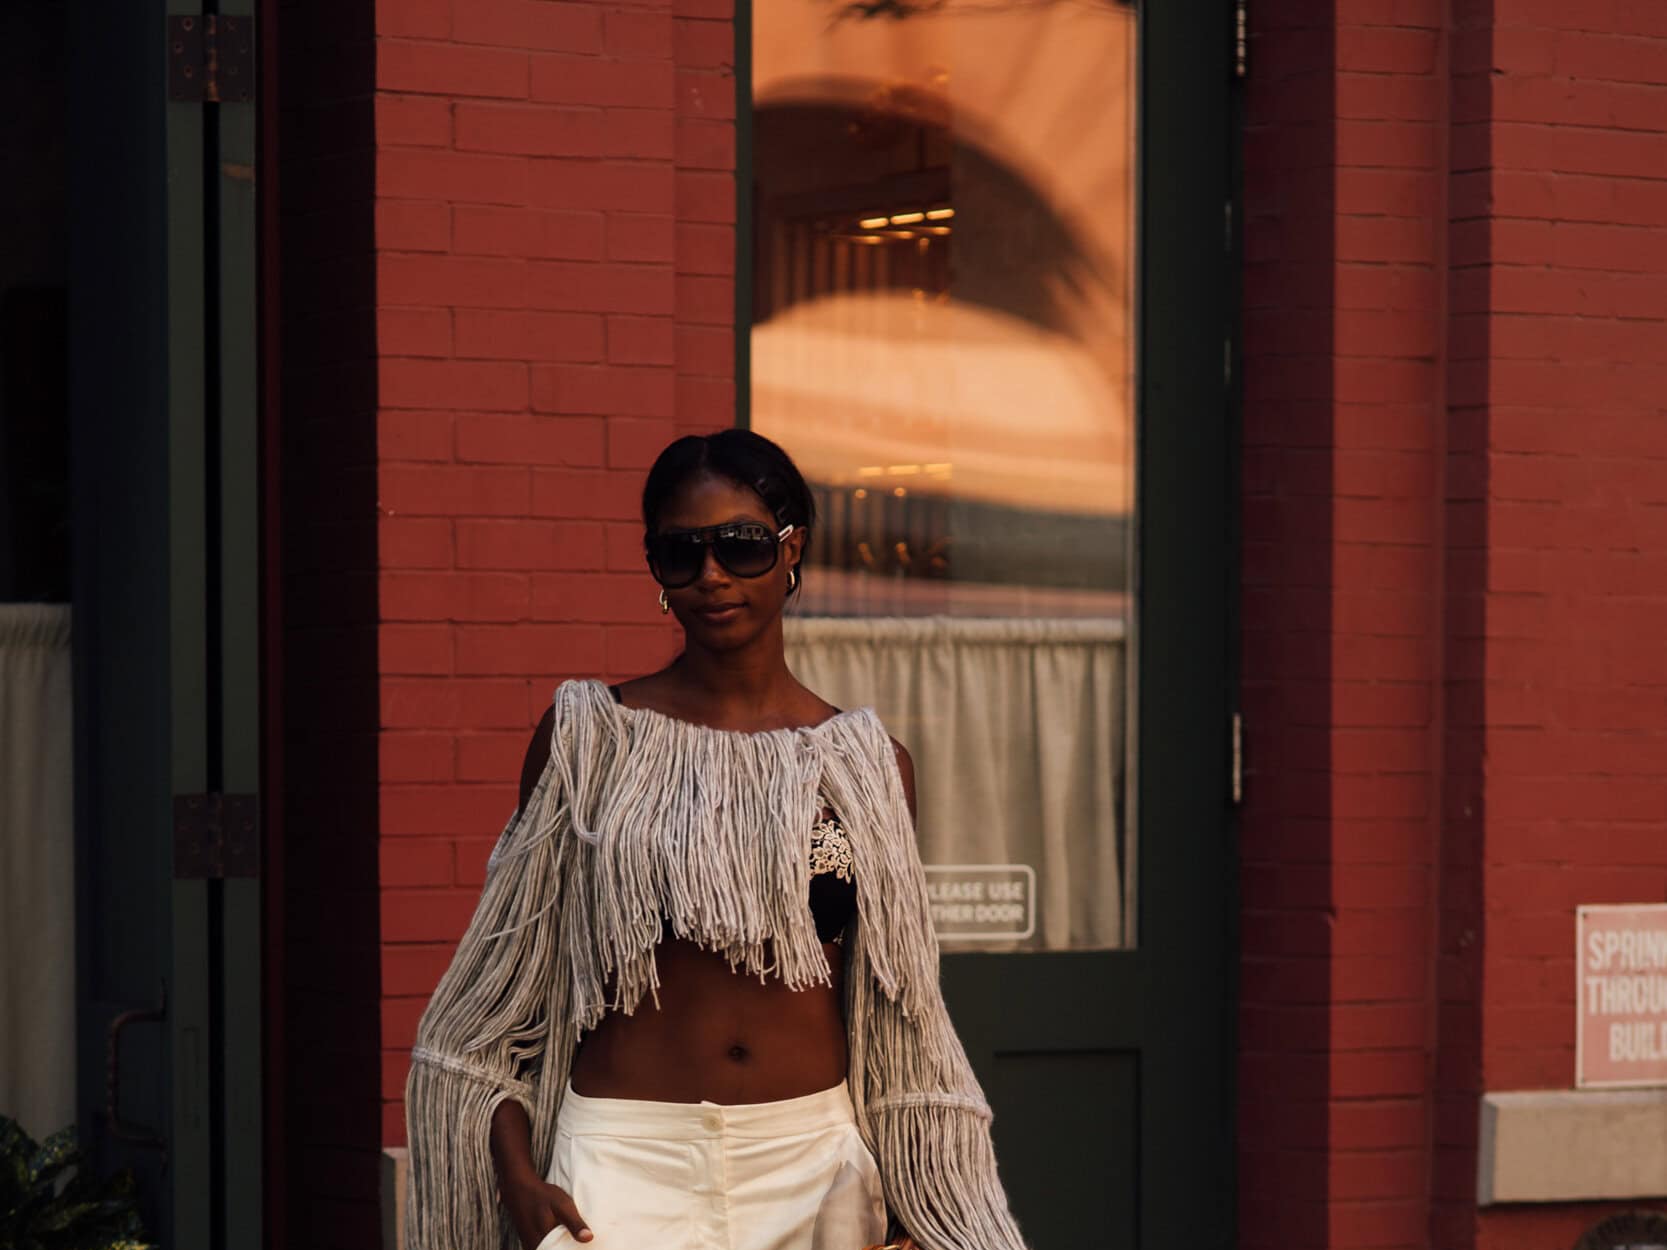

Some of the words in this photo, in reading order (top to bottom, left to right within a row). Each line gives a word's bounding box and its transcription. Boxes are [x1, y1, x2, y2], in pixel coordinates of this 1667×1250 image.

[927, 882, 983, 901] LEASE
[987, 882, 1024, 901] USE
[930, 903, 974, 922] THER
[975, 903, 1024, 922] DOOR
[1586, 975, 1667, 1015] THROU
